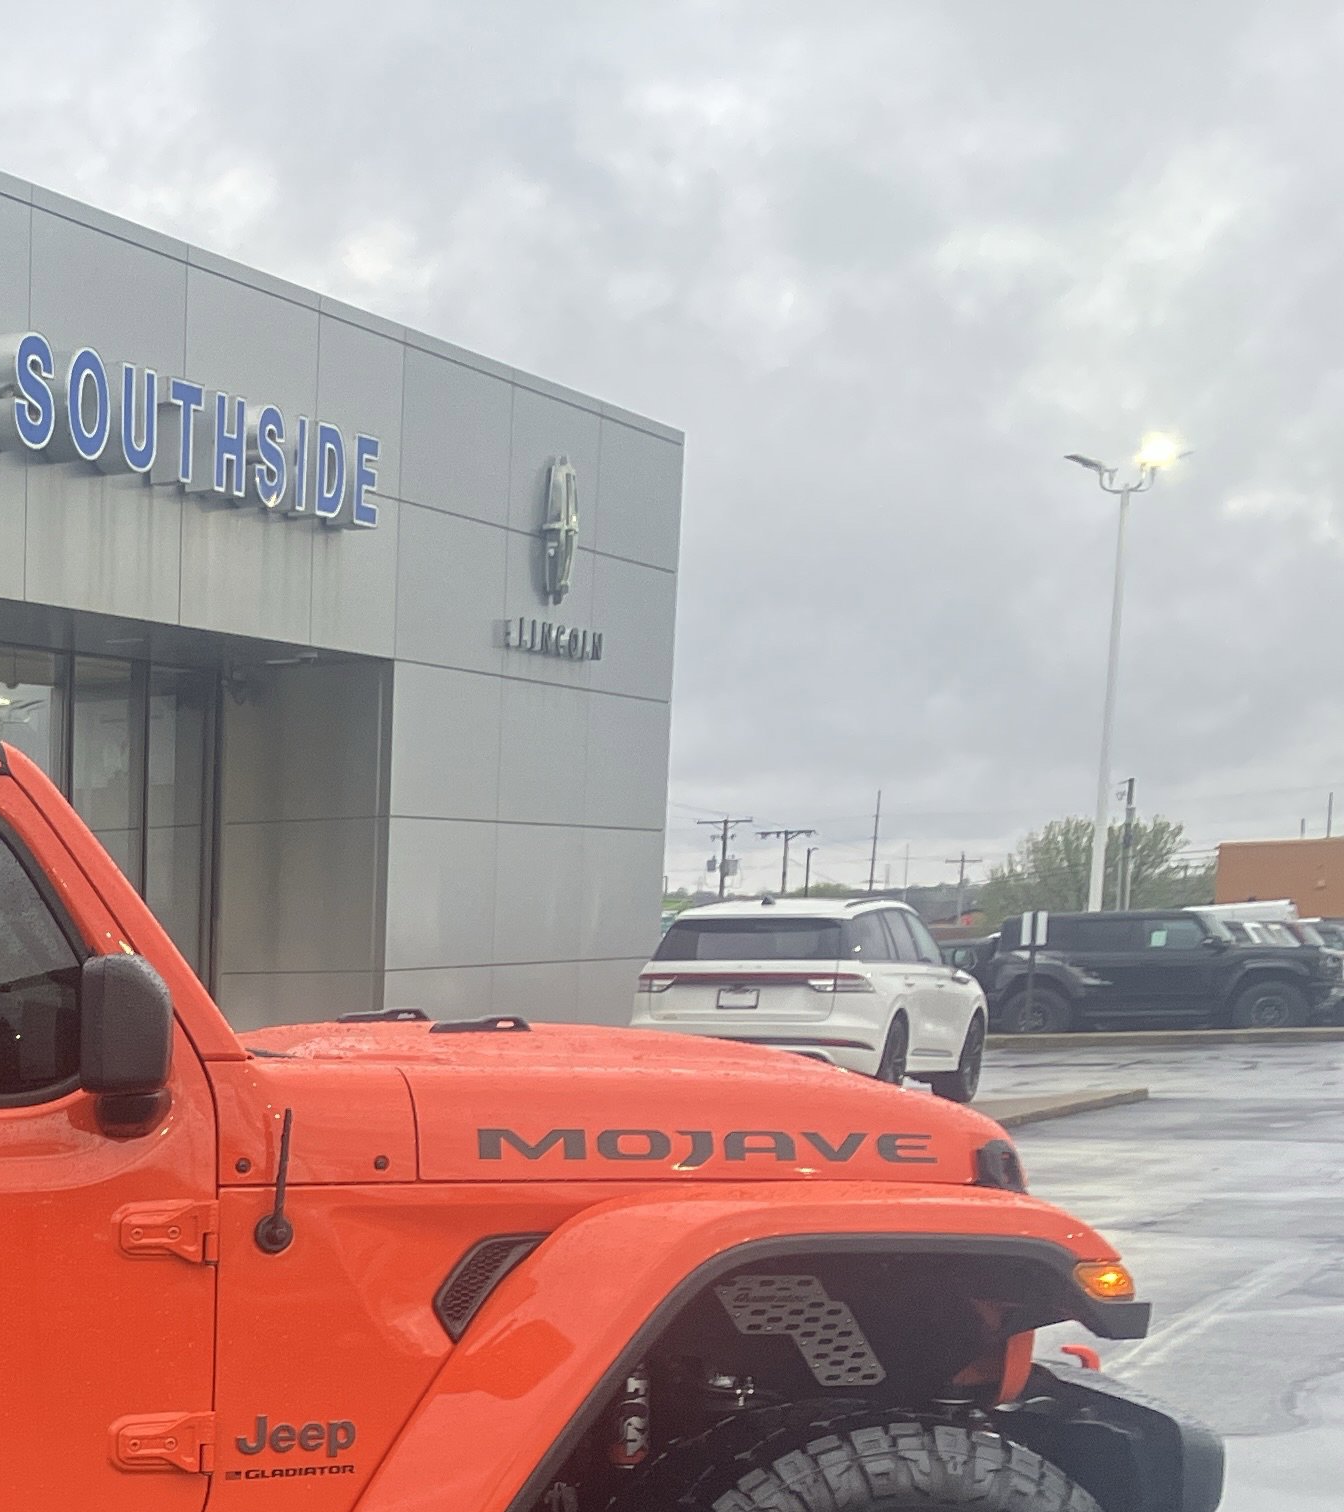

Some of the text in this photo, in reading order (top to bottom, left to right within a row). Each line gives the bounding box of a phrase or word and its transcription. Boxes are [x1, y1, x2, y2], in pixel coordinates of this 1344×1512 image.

[14, 331, 381, 529] SOUTHSIDE
[516, 616, 604, 661] LINCOLN
[476, 1127, 939, 1168] MOJAVE
[235, 1414, 356, 1458] Jeep
[244, 1464, 356, 1481] GLADIATOR
